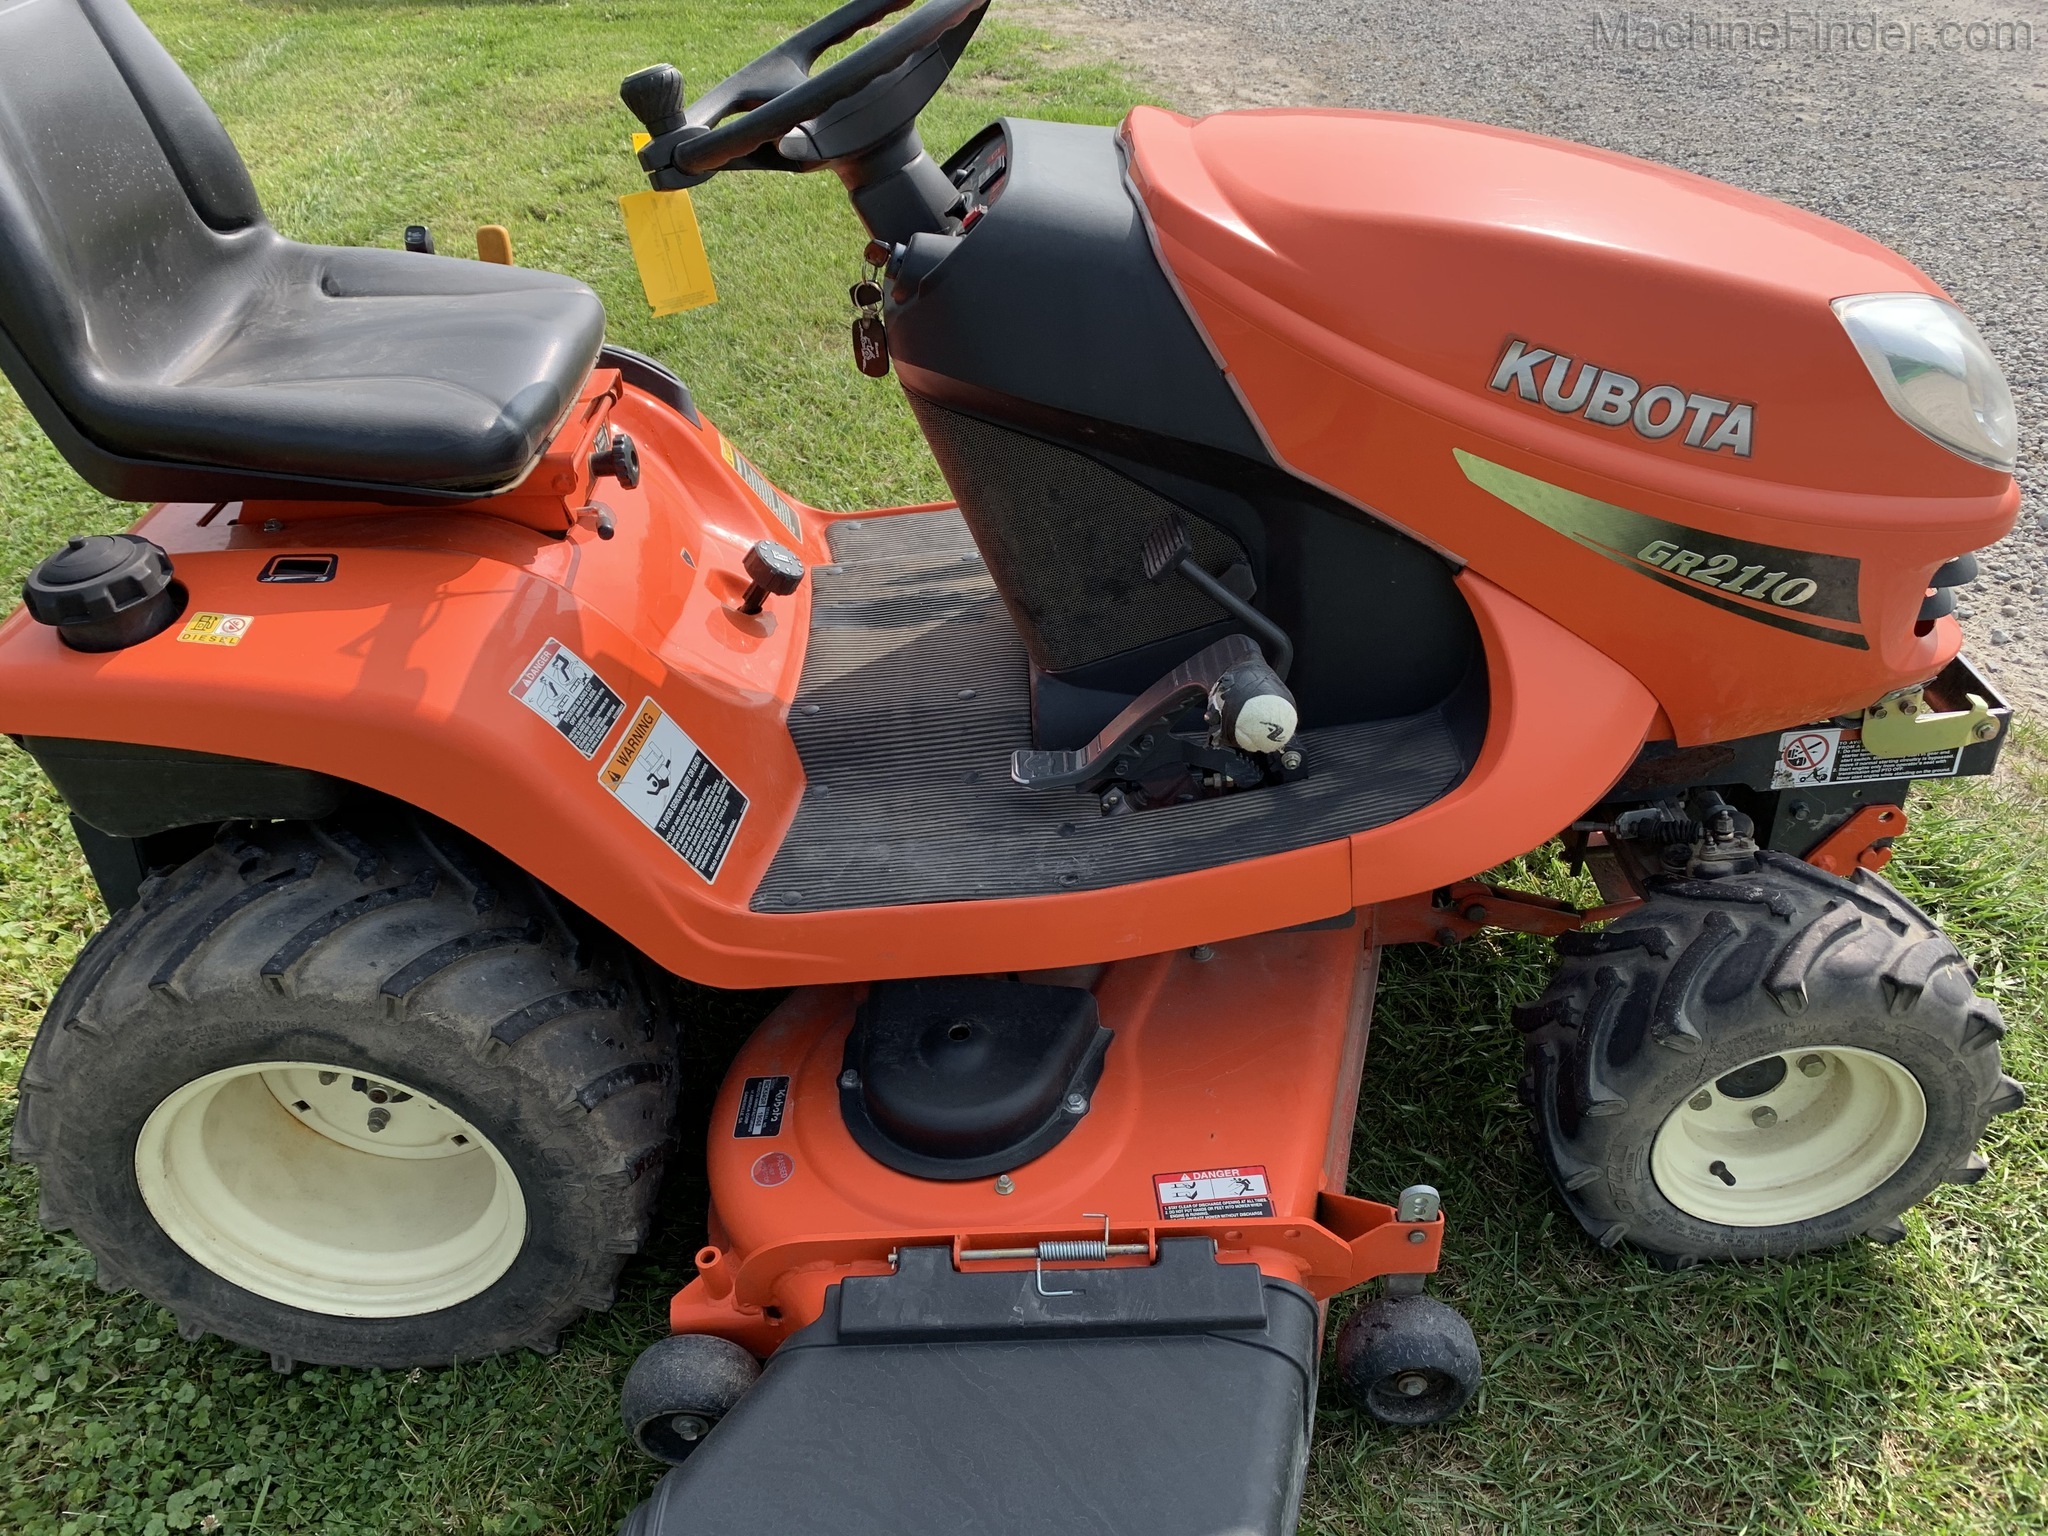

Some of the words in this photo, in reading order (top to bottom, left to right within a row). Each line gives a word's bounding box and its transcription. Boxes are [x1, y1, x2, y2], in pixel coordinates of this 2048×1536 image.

[1490, 339, 1754, 458] KUBOTA
[1636, 539, 1818, 606] GR2110
[182, 633, 236, 644] DIESEL
[526, 649, 552, 680] DANGER
[616, 711, 654, 768] WARNING
[690, 754, 702, 771] DEATH
[687, 767, 695, 778] OR
[679, 774, 691, 792] INJURY
[669, 788, 684, 811] SERIOUS
[662, 806, 674, 824] AVOID
[658, 820, 667, 831] TO
[770, 1089, 785, 1121] Kubota
[1192, 1168, 1239, 1179] DANGER
